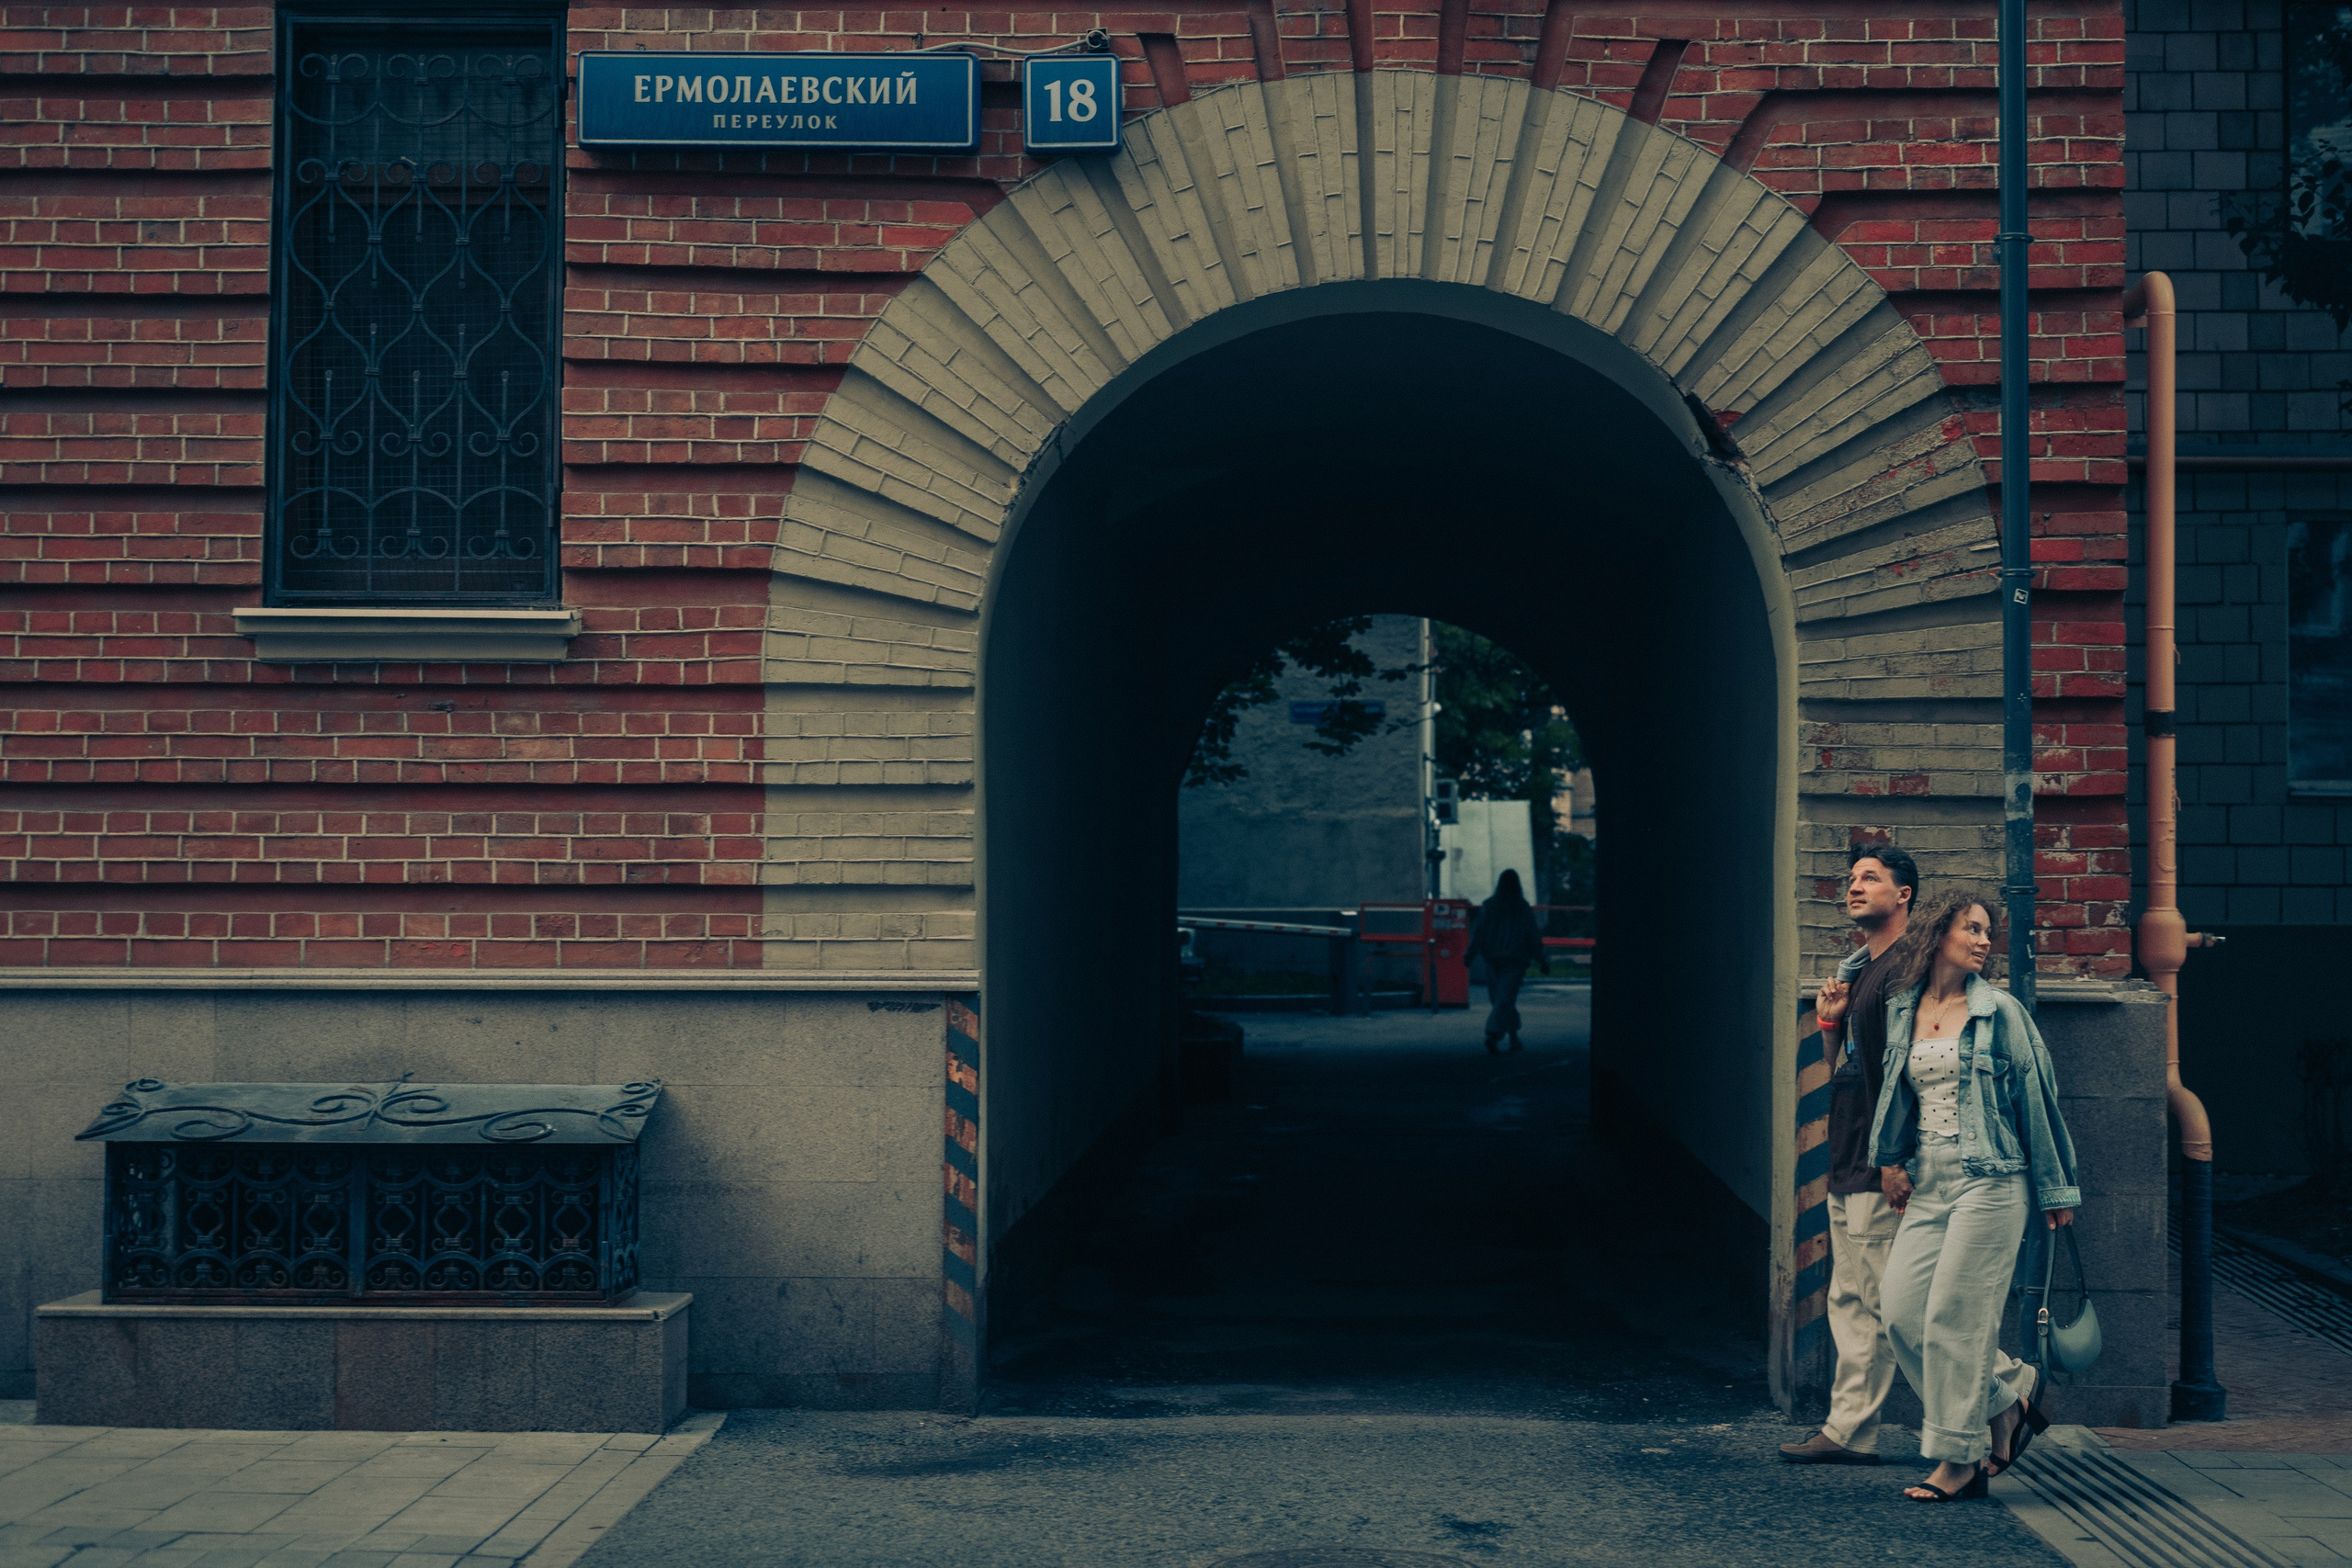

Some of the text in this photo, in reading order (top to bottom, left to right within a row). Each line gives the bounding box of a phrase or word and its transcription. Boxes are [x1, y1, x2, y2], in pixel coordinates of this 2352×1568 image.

[634, 71, 918, 105] ЕРМОЛАЕВСКИЙ
[1043, 79, 1098, 122] 18
[712, 114, 838, 130] ПЕРЕУЛОК
